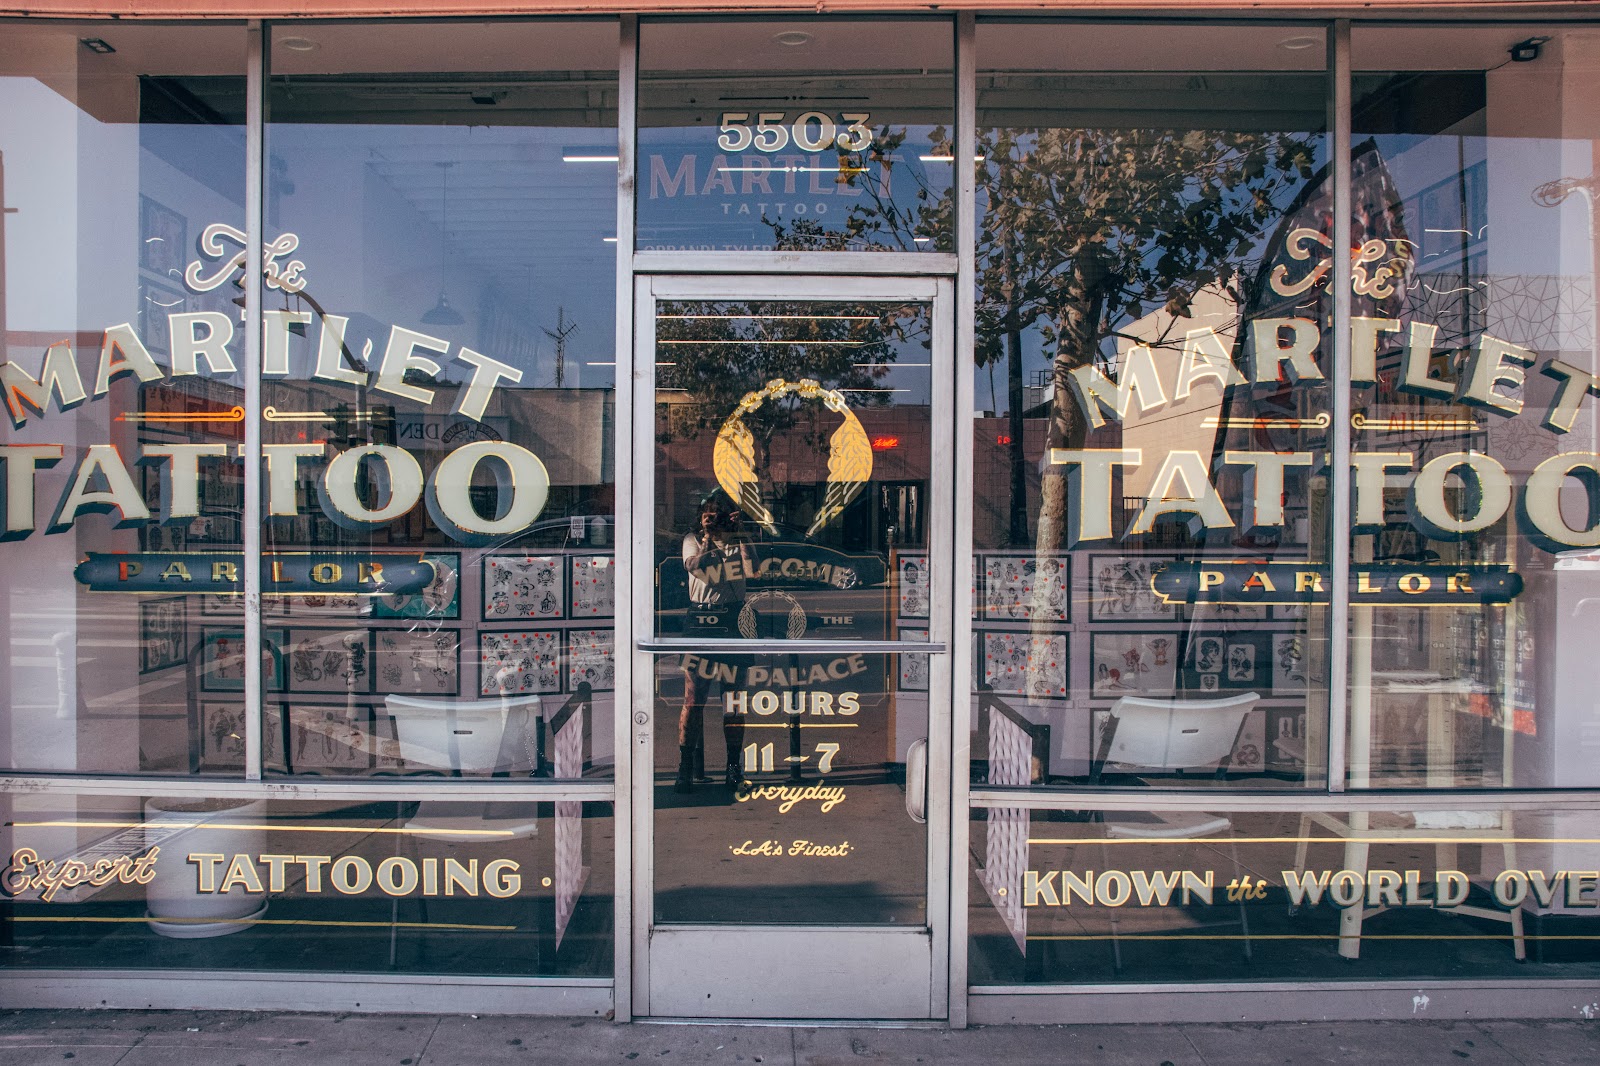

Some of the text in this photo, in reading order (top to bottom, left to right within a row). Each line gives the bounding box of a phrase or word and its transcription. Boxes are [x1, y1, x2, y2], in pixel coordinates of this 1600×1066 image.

[717, 111, 873, 152] 5503
[720, 203, 828, 214] TATTOO
[185, 223, 306, 292] The
[1270, 228, 1395, 299] The
[0, 311, 523, 425] MARTLET
[1069, 316, 1600, 433] MARTLET
[0, 441, 550, 534] TATTOO
[1050, 448, 1600, 547] TATTOO
[118, 561, 384, 583] PARLOR
[697, 557, 852, 588] WELCOME
[1199, 571, 1475, 594] PARLOR
[696, 615, 853, 625] TO THE
[681, 654, 868, 686] FUN PALACE
[726, 690, 860, 716] HOURS
[743, 742, 774, 773] 11
[814, 742, 840, 773] 7
[734, 779, 846, 814] Everyday
[733, 839, 850, 857] LA's Finest
[2, 846, 522, 902] Expert TATTOOING
[1023, 869, 1215, 907] KNOWN
[1226, 875, 1267, 902] the
[1281, 869, 1470, 907] WORLD
